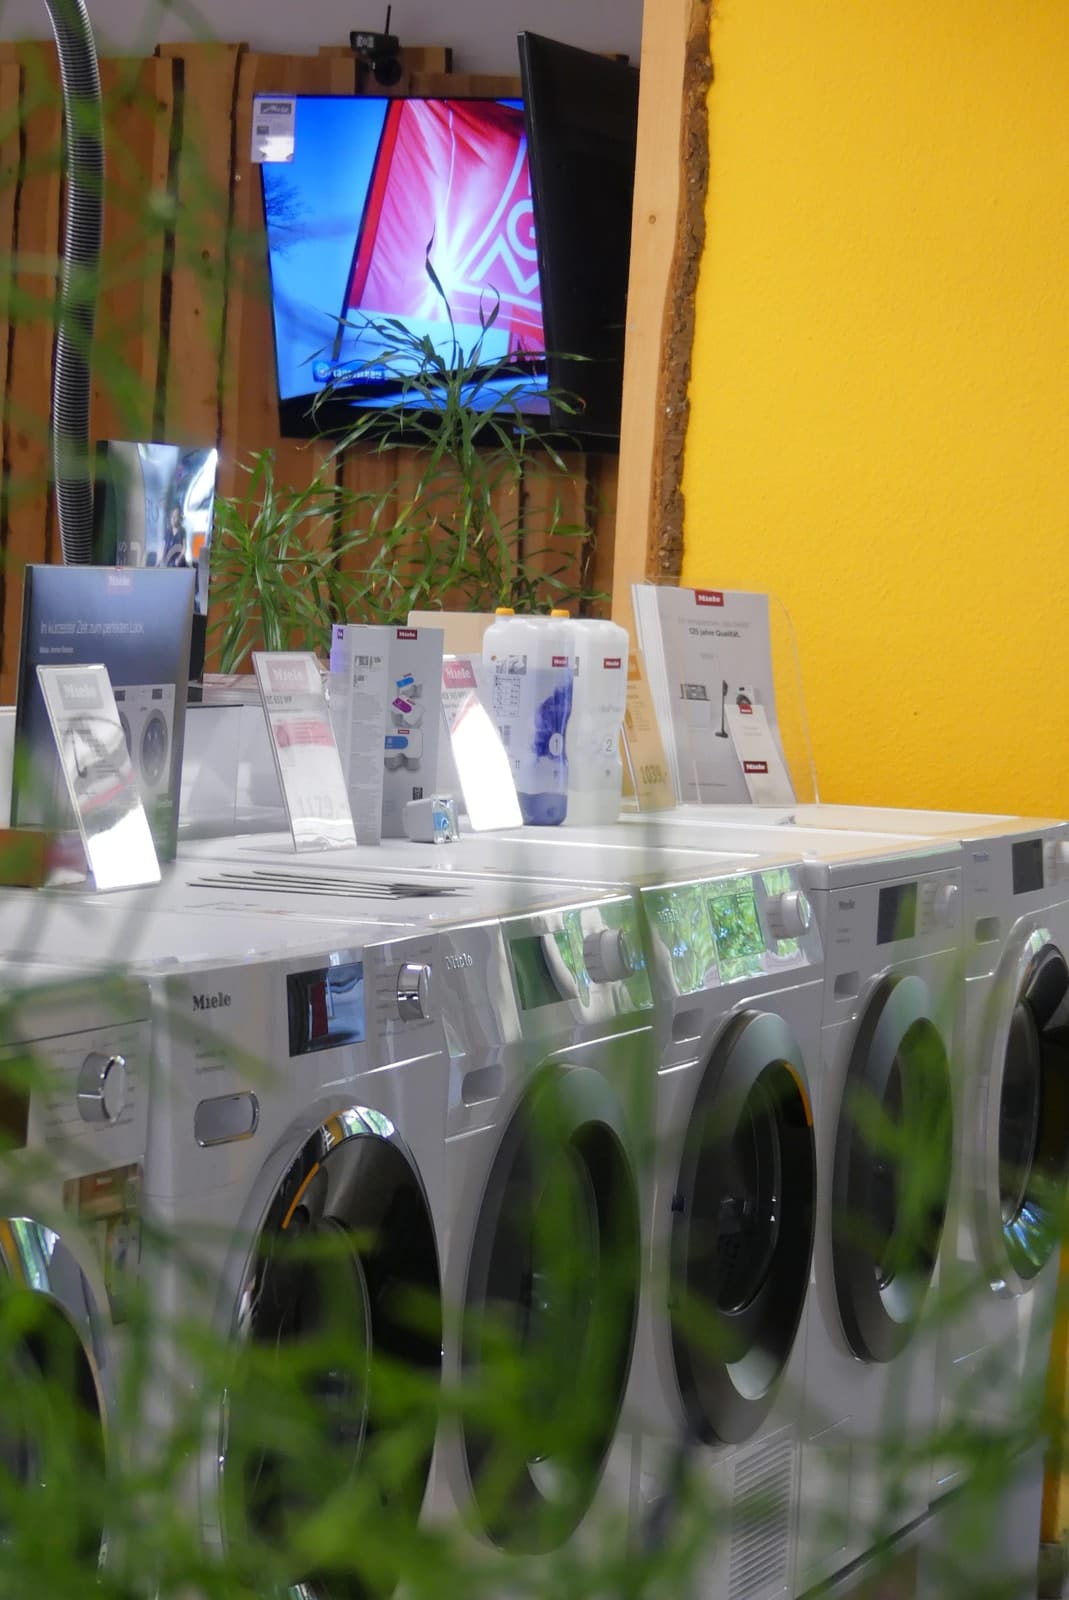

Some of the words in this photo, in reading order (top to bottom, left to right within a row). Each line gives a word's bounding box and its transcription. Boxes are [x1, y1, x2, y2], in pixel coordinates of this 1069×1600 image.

[697, 594, 721, 603] Miele
[445, 666, 472, 679] Miele
[605, 738, 613, 753] 2
[192, 991, 232, 1012] Miele
